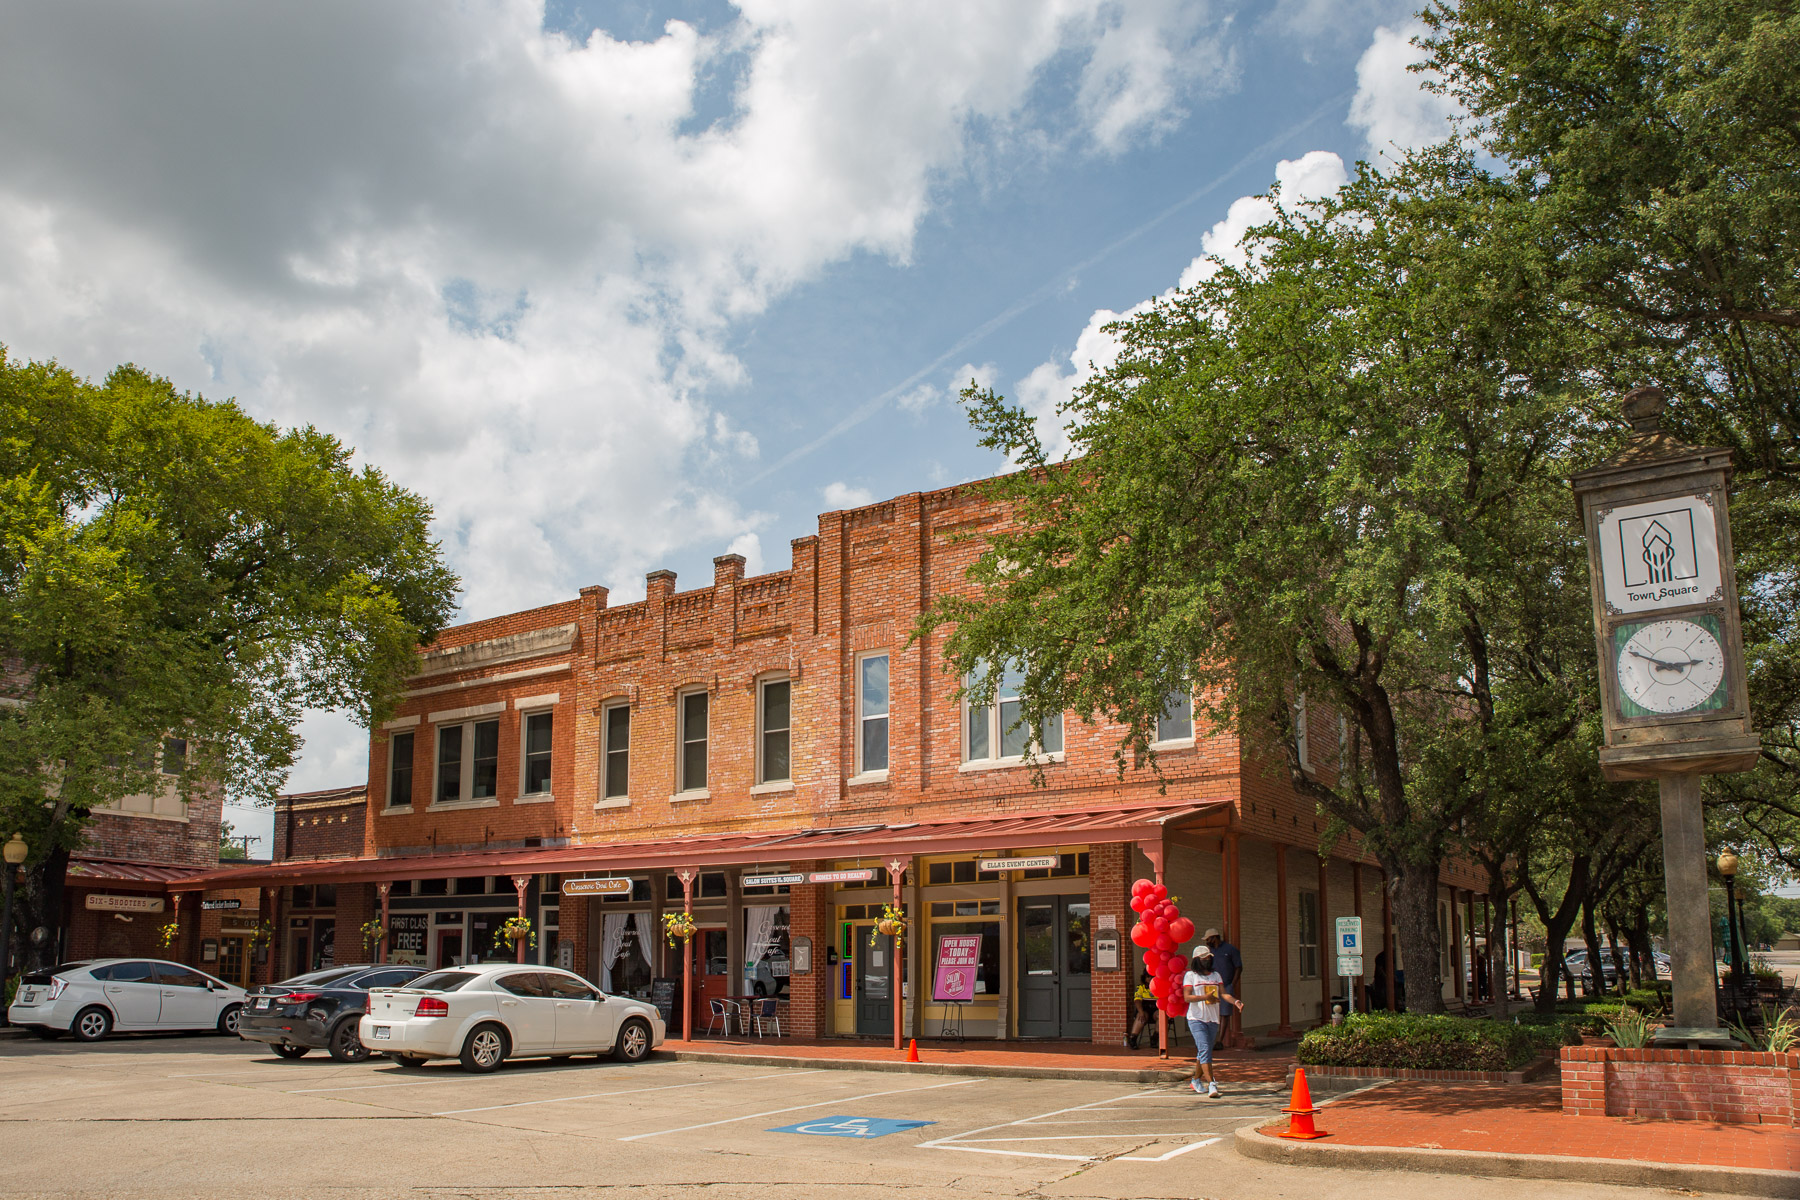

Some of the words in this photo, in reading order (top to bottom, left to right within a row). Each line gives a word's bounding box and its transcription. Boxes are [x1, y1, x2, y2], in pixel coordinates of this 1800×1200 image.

[1627, 593, 1660, 601] Town
[1660, 586, 1698, 597] Square
[1006, 860, 1026, 868] EVENT
[1026, 859, 1050, 867] CENTER
[815, 873, 832, 881] HOMES
[832, 873, 840, 881] TO
[840, 872, 847, 880] GO
[847, 872, 866, 880] REALTY
[595, 881, 607, 889] Soul
[609, 881, 621, 889] Cafe
[89, 897, 147, 907] SIX-SHOOTERS
[391, 918, 409, 929] FIRST
[397, 933, 422, 949] FREE
[944, 939, 958, 948] OPEN
[959, 939, 976, 947] HOUSE
[949, 947, 969, 957] TODAY
[941, 957, 957, 965] PLEASE
[957, 957, 967, 965] JOIN
[967, 957, 975, 965] US
[946, 972, 960, 985] SALON
